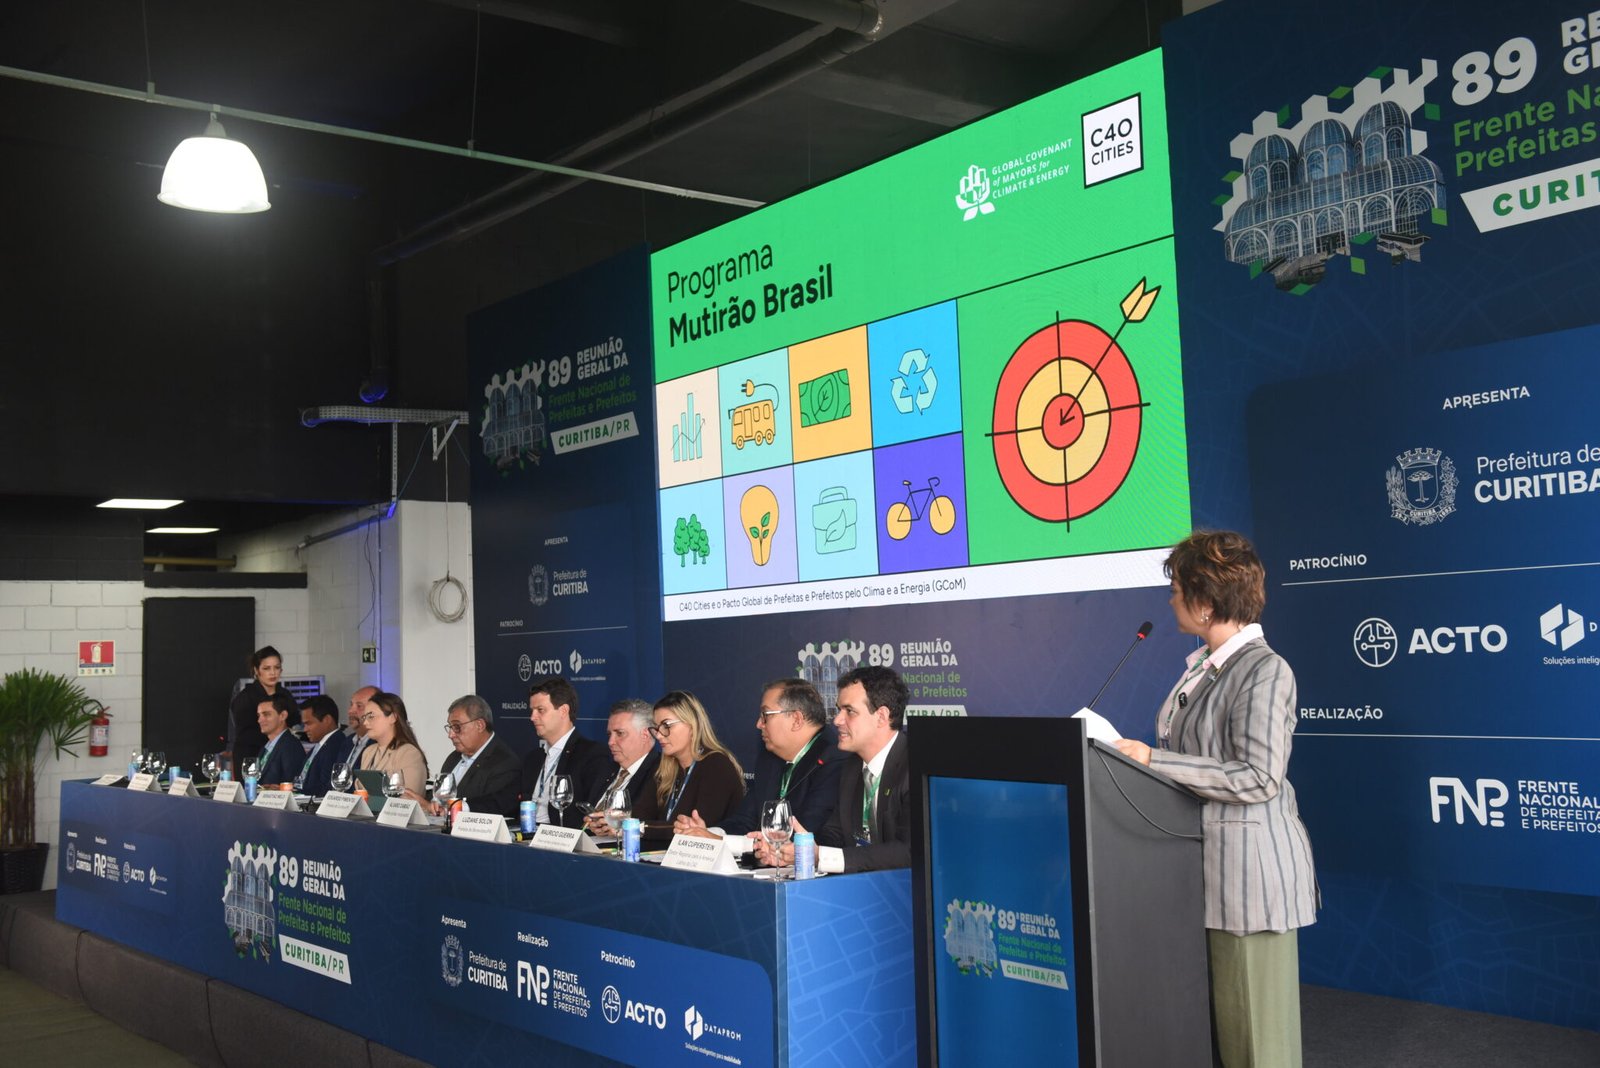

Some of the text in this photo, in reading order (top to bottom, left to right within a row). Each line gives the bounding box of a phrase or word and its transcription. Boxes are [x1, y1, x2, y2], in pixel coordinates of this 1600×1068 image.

[1451, 36, 1538, 106] 89
[1454, 100, 1555, 147] Frente
[992, 138, 1073, 175] GLOBAL COVENANT
[1091, 140, 1134, 166] CITIES
[1455, 121, 1597, 177] Prefeitas
[992, 164, 1070, 199] CLIMATE & ENERGY
[993, 160, 1050, 187] of MAYORS for
[667, 244, 773, 303] Programa
[669, 262, 833, 348] Mutirão Brasil
[548, 336, 623, 388] 89 REUNIÃO
[577, 352, 629, 381] GERAL DA
[578, 377, 617, 399] Nacional
[619, 374, 631, 387] de
[596, 390, 637, 411] Prefeitos
[1442, 386, 1530, 410] APRESENTA
[558, 418, 630, 448] CURITIBA/PR
[1477, 444, 1600, 475] Prefeitura de
[1290, 553, 1367, 571] PATROCÍNIO
[553, 581, 588, 597] CURITIBA
[722, 598, 740, 608] Pacto
[742, 595, 762, 607] Global
[764, 595, 772, 605] de
[774, 592, 804, 604] Prefeitas
[811, 588, 843, 601] Prefeitos
[845, 587, 861, 600] pelo
[863, 584, 885, 598] Clima
[887, 587, 892, 595] e
[894, 586, 899, 594] a
[900, 582, 931, 596] Energia
[932, 577, 966, 593] (GCoM)
[1408, 624, 1508, 654] ACTO
[868, 638, 952, 667] 89 REUNIÃO
[901, 654, 958, 667] GERAL DA
[1543, 656, 1575, 666] Soluções
[534, 659, 562, 675] ACTO
[902, 671, 960, 684] Nacional de
[913, 688, 920, 697] e
[922, 685, 968, 698] Prefeitos
[1300, 705, 1383, 721] REALIZAÇÃO
[1518, 780, 1579, 795] FRENTE
[1519, 793, 1600, 809] NACIONAL
[1520, 807, 1538, 818] DE
[1522, 818, 1530, 829] E
[130, 868, 145, 882] ACTO
[278, 854, 341, 888] 89 REUNIÃO
[303, 876, 345, 901] GERAL DA
[279, 893, 347, 924] Frente Nacional de
[279, 910, 351, 945] Prefeitas e Prefeitos
[441, 915, 467, 929] Apresenta
[1020, 912, 1056, 928] REUNIÃO
[517, 931, 549, 948] Realização
[1020, 923, 1061, 940] GERAL DA
[285, 942, 344, 974] CURITIBA/PR
[469, 951, 507, 972] Prefeitura de
[600, 950, 636, 968] Patrocínio
[467, 967, 508, 992] CURITIBA
[553, 969, 578, 984] FRENTE
[1006, 964, 1062, 984] CURITIBA/PR
[553, 982, 587, 998] NACIONAL
[553, 990, 590, 1009] DE PREFEITAS
[558, 1002, 588, 1018] PREFEITOS
[624, 1000, 667, 1030] ACTO
[704, 1023, 742, 1041] DATAPROM
